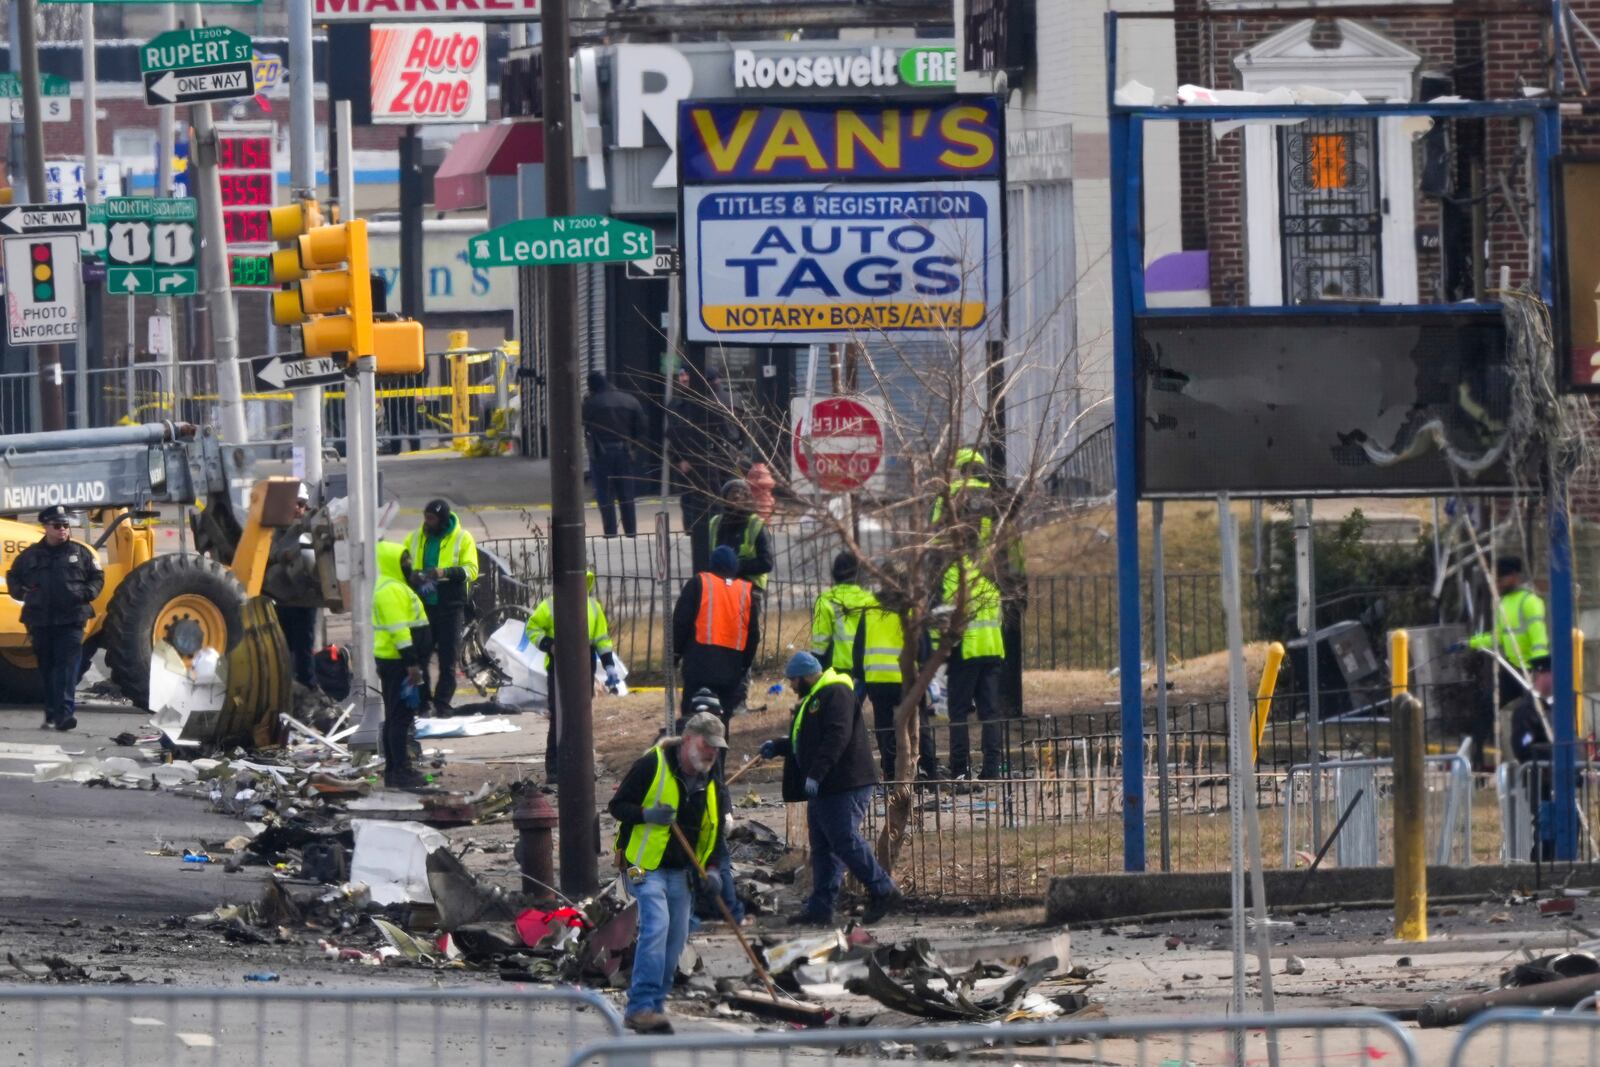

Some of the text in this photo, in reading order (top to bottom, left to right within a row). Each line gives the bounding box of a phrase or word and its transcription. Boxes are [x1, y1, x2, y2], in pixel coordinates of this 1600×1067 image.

[146, 40, 248, 68] RUPERT ST
[404, 27, 480, 69] Auto
[735, 46, 956, 89] Roosevelt FRE
[177, 73, 242, 92] ONE WAY
[388, 71, 471, 115] Zone
[691, 106, 995, 172] VAN'S
[23, 211, 77, 226] ONE WAY
[109, 201, 149, 214] NORTH
[715, 195, 970, 215] TITLES & REGISTRATION
[553, 218, 597, 232] N 7200
[123, 228, 134, 256] 1
[165, 230, 176, 257] 1
[499, 231, 649, 262] Leonard St
[751, 225, 935, 255] AUTO
[656, 255, 671, 268] ON
[725, 256, 961, 297] TAGS
[23, 306, 67, 320] PHOTO
[725, 307, 815, 327] NOTARY
[285, 361, 314, 378] ONE
[812, 416, 864, 432] ENTER
[4, 480, 105, 508] NEW HOLLAND
